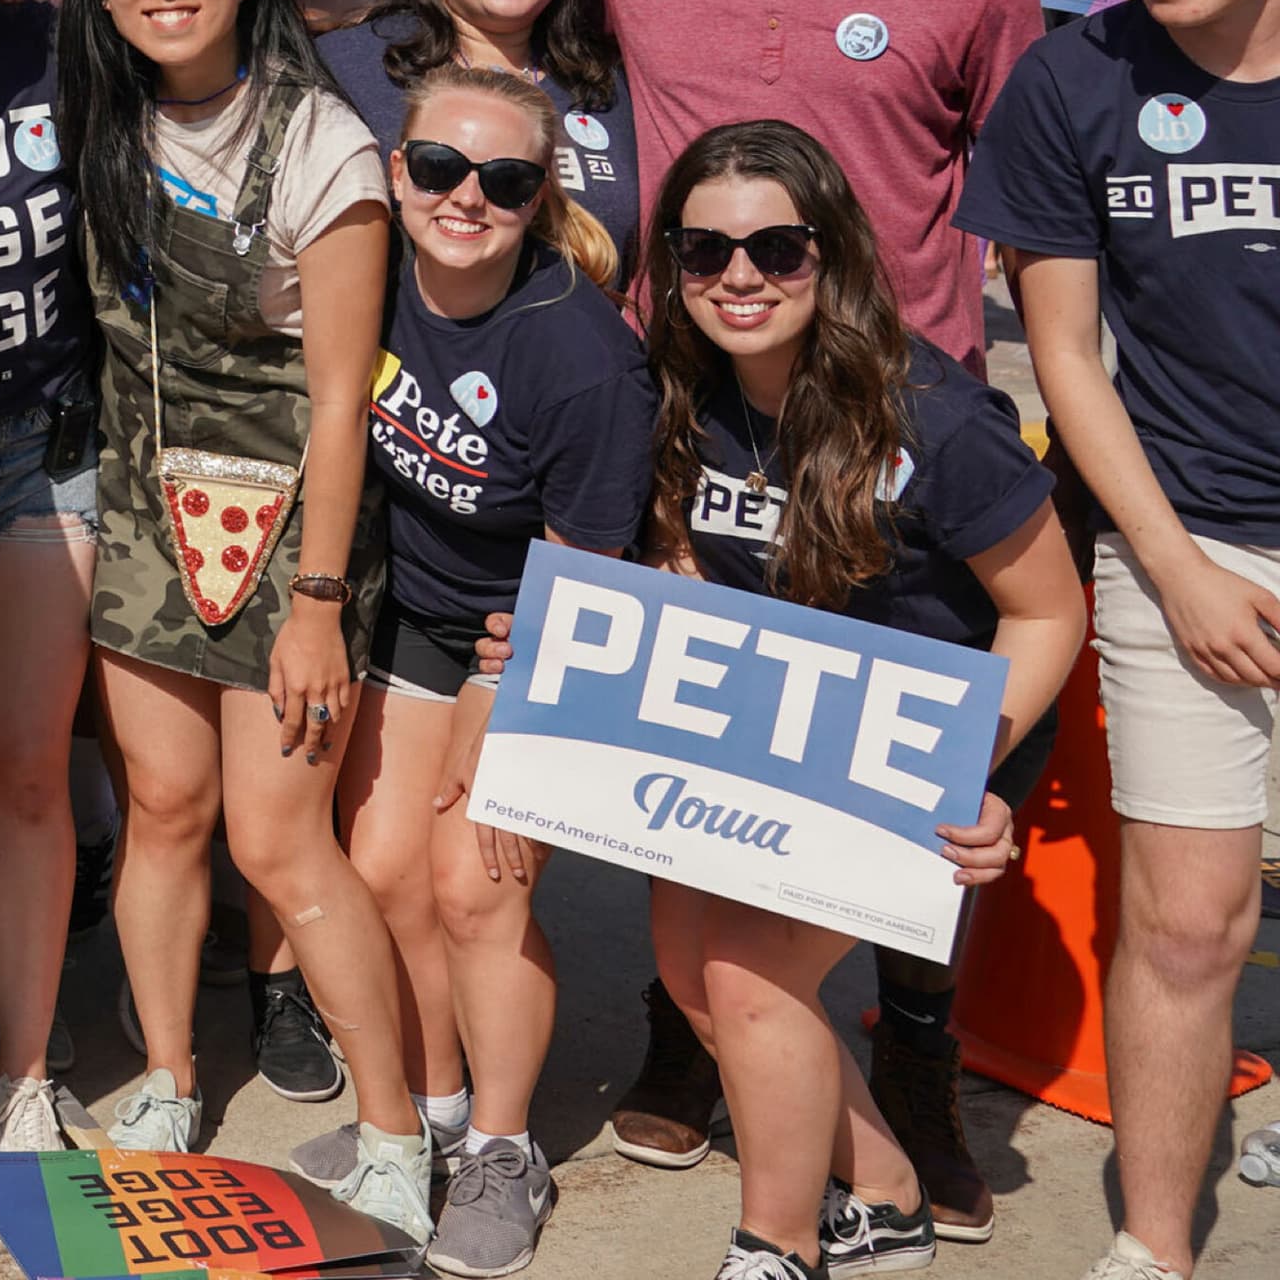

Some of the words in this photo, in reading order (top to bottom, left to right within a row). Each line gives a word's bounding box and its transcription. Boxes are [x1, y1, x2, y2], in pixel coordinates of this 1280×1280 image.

[588, 158, 612, 175] 20
[1107, 185, 1154, 209] 20
[1181, 175, 1280, 222] PET
[378, 367, 490, 467] Pete
[372, 415, 484, 516] tigieg
[527, 576, 970, 812] PETE
[484, 798, 674, 867] PeteForAmerica.com
[634, 771, 793, 857] Iowa
[783, 887, 804, 900] PAID
[806, 893, 824, 906] FOR
[840, 902, 864, 918] PETE
[865, 910, 884, 924] FOR
[885, 916, 930, 939] AMERICA
[68, 1168, 246, 1198] EDGE
[93, 1191, 274, 1229] EDGE
[129, 1219, 306, 1265] BOOT
